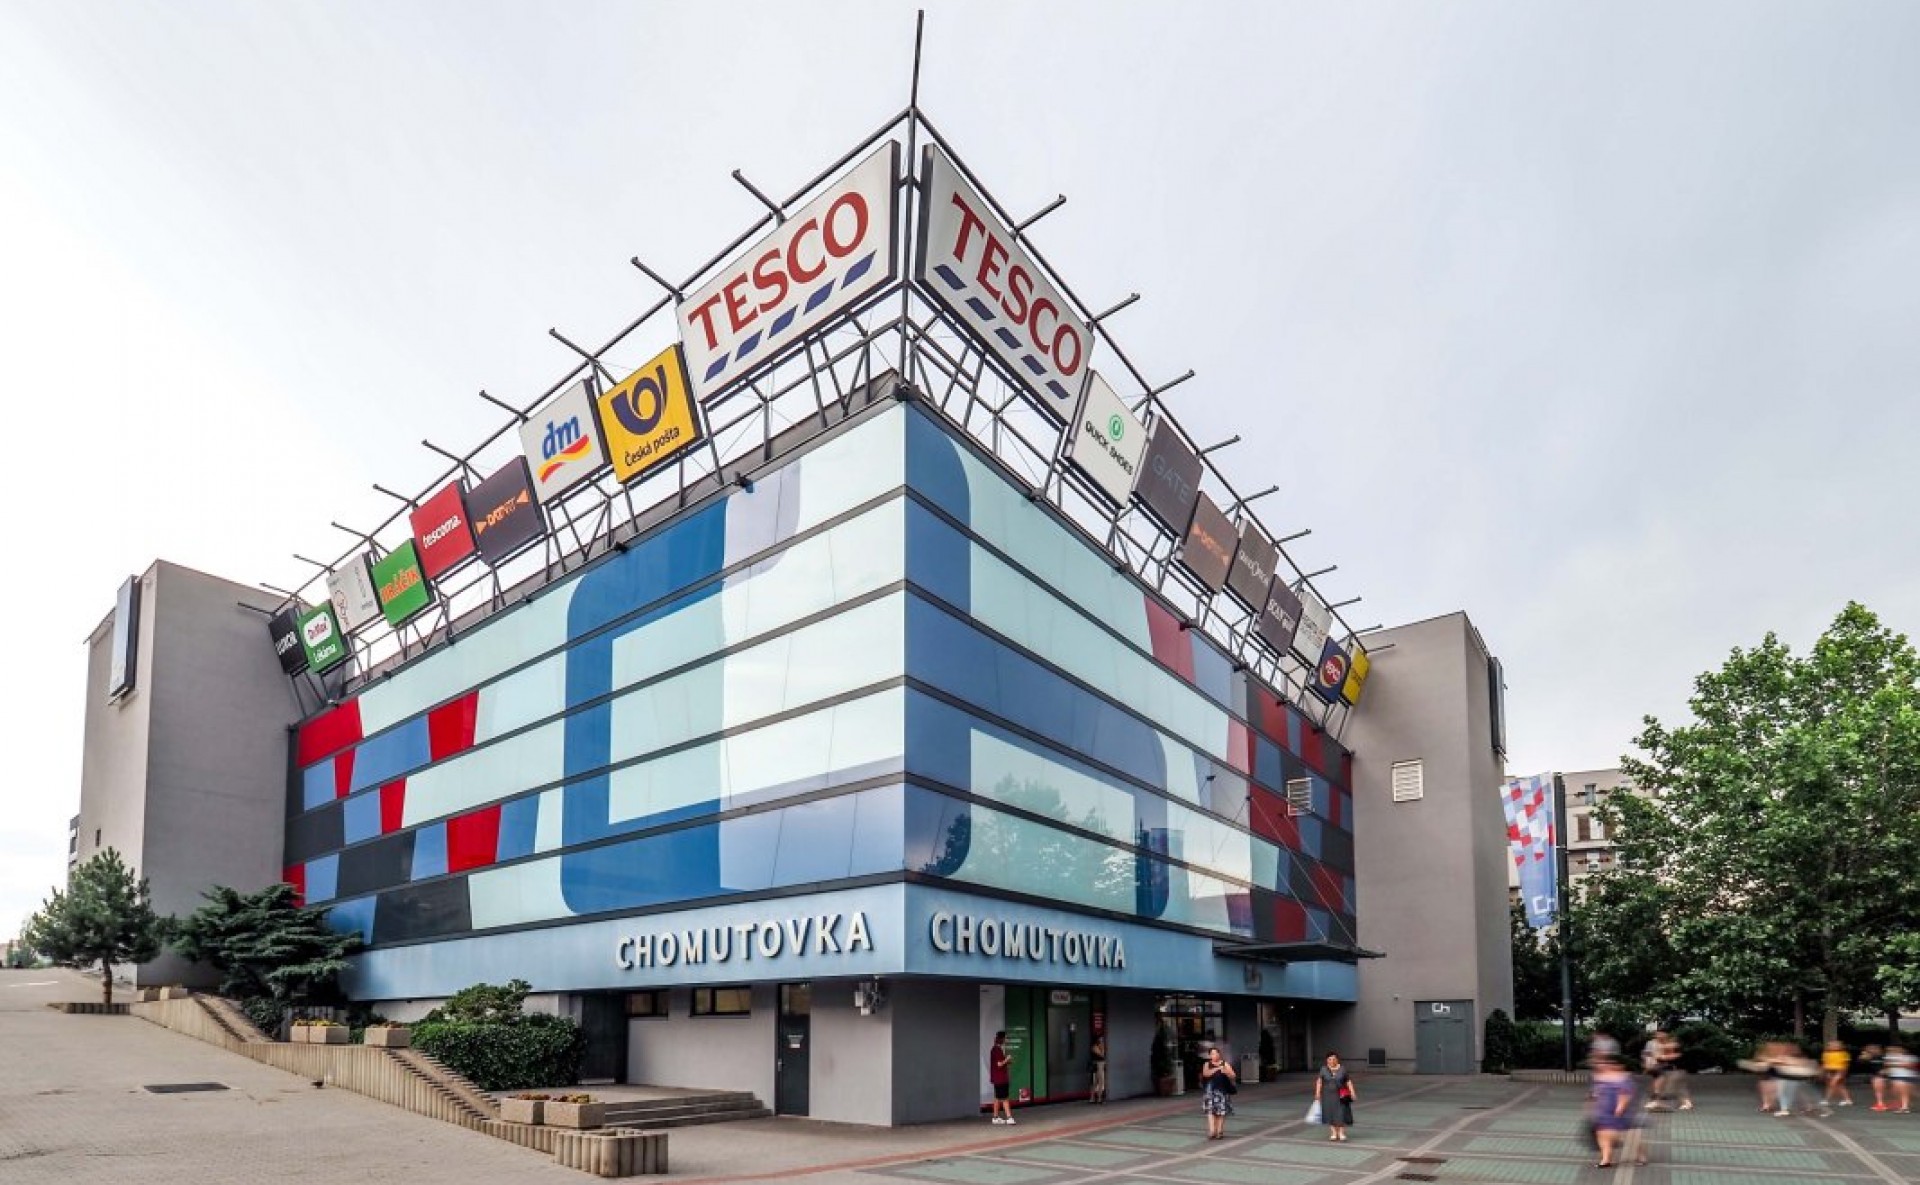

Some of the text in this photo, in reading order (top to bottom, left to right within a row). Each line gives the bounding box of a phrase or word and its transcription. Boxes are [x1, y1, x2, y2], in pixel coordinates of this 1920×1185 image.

[687, 190, 870, 352] TESCO
[951, 191, 1082, 377] TESCO
[542, 415, 580, 460] dm
[624, 425, 680, 467] Česká pošta
[1085, 420, 1133, 475] QUICK SHOES
[1152, 453, 1192, 505] GATE
[614, 910, 874, 971] CHOMUTOVKA
[930, 909, 1127, 969] CHOMUTOVKA
